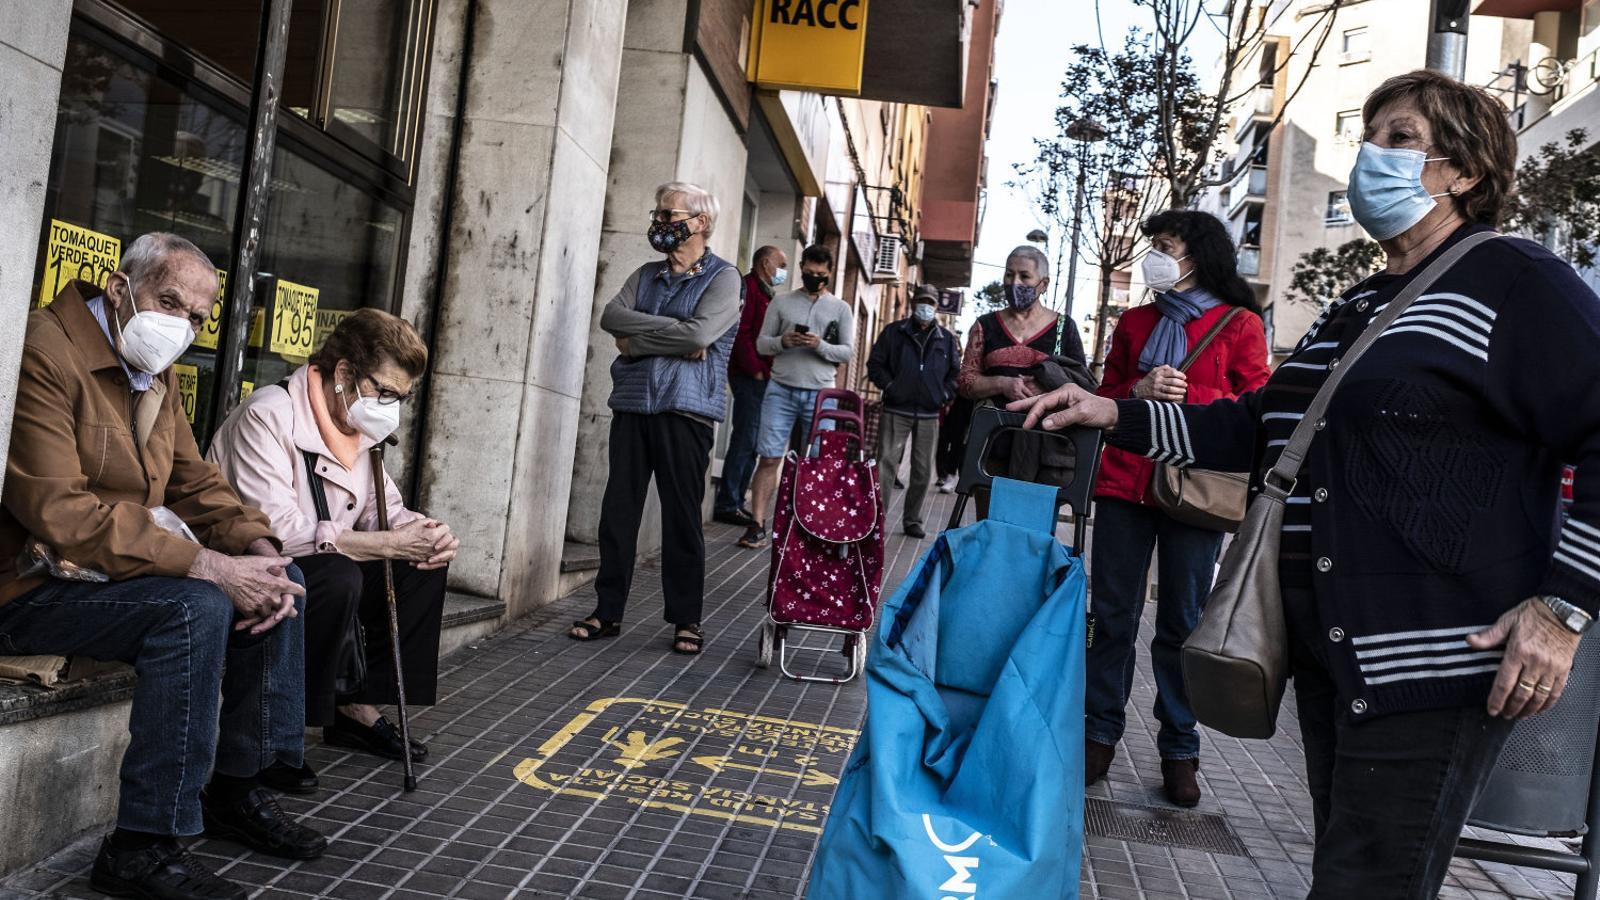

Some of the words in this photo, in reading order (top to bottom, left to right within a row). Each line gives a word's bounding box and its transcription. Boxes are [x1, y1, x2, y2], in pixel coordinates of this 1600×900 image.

[770, 0, 858, 30] RACC
[50, 243, 89, 264] VERDE
[276, 310, 313, 347] 1.95
[740, 719, 854, 740] STANCIA
[700, 785, 831, 814] STANCIA
